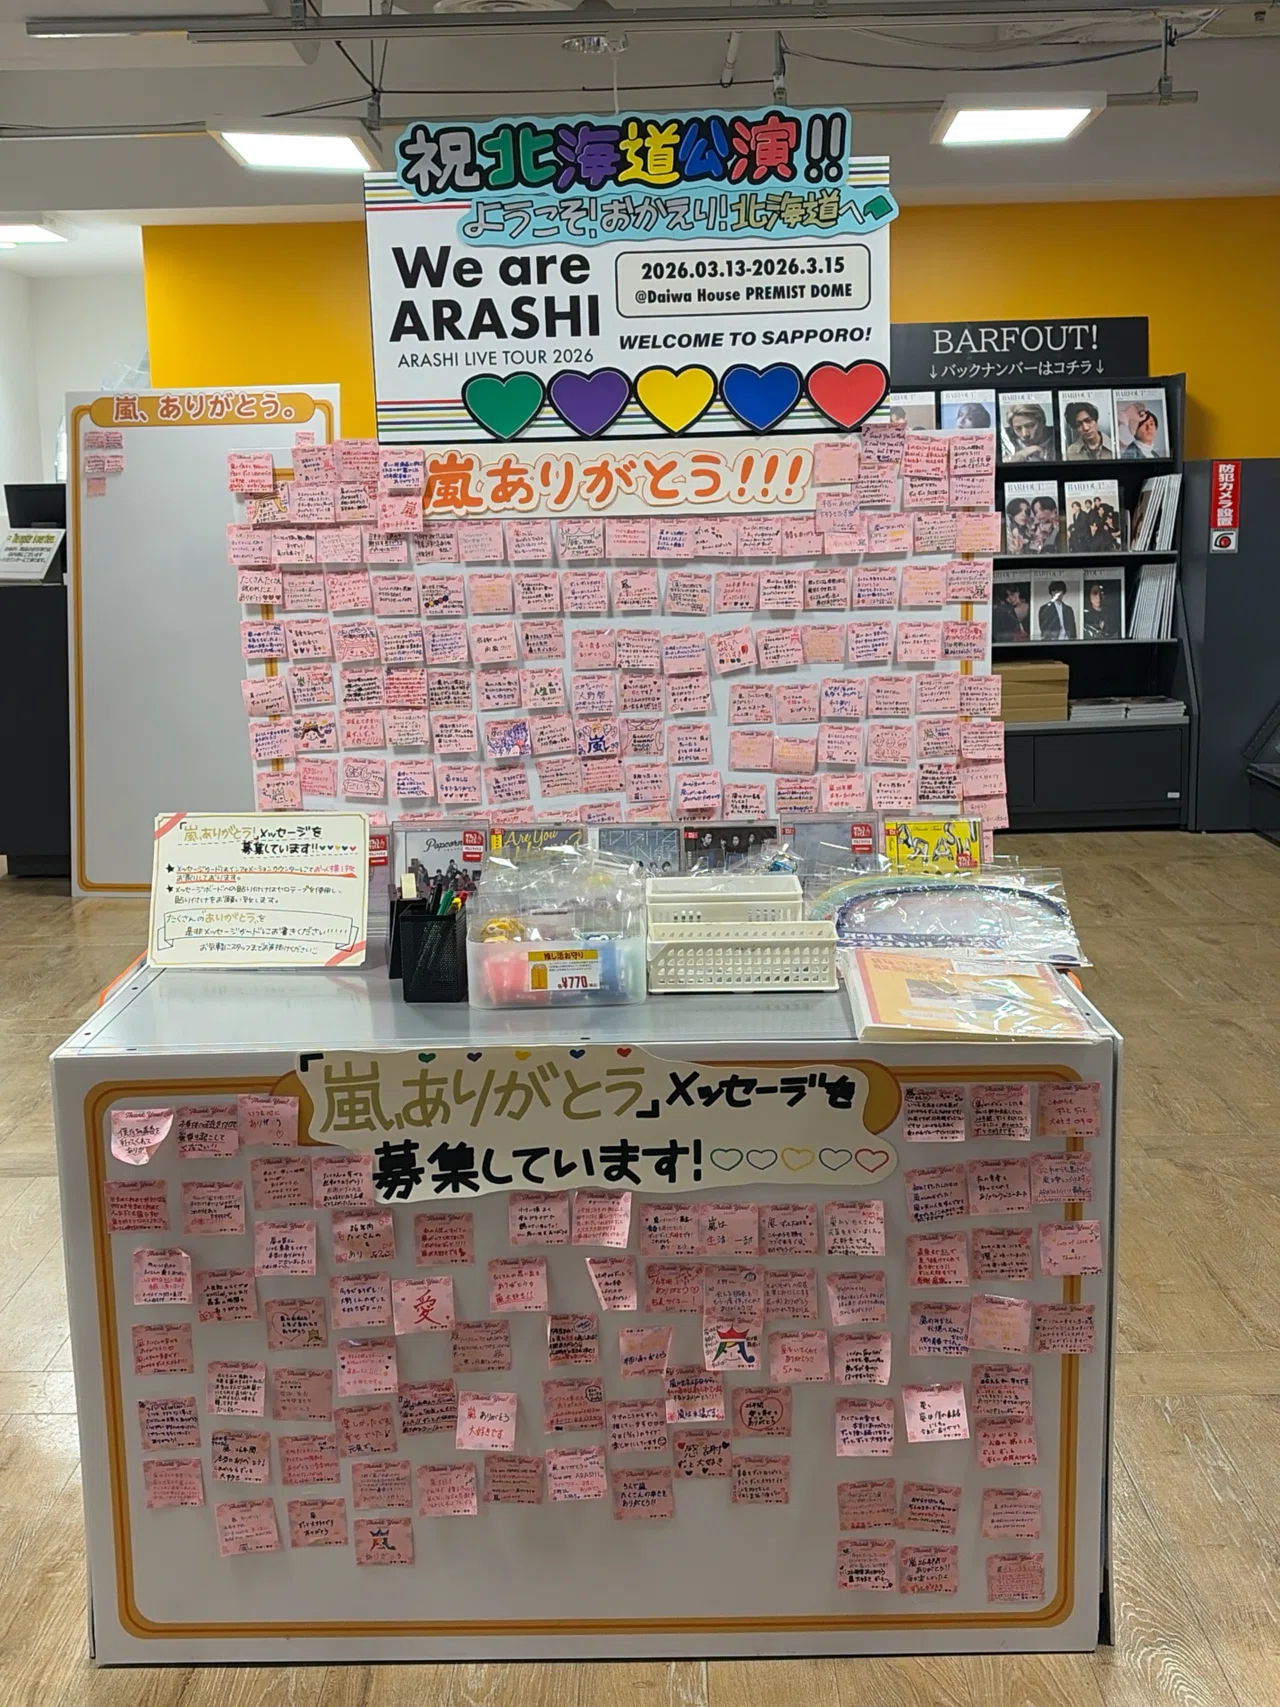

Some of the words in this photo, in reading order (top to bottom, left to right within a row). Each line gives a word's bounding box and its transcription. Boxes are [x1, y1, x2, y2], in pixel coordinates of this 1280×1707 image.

[401, 112, 844, 194] 祝北海道公演!!
[391, 247, 483, 289] We
[499, 251, 591, 287] are
[641, 256, 845, 281] 2026.03.13-2026.3.15
[635, 288, 693, 306] @Daiwa
[697, 288, 740, 303] House
[745, 285, 808, 301] PREMIST
[810, 284, 853, 299] DOME
[390, 295, 600, 343] ARASHI
[619, 332, 723, 350] WELCOME
[728, 331, 757, 349] TO
[760, 327, 873, 347] SAPPORO!
[932, 326, 1100, 355] BARFOUT!
[398, 352, 459, 368] ARASHI
[465, 351, 497, 366] LIVE
[502, 350, 547, 365] TOUR
[553, 349, 594, 364] 2026
[941, 362, 1092, 378] バックナンバーはコチラ
[114, 393, 296, 421] 嵐、ありがとう。
[1217, 463, 1236, 527] 防犯カメラ設置
[210, 1106, 228, 1114] You!
[346, 1156, 362, 1164] You!
[373, 1139, 703, 1201] 募集しています!
[982, 1160, 1000, 1168] Thank
[920, 1234, 938, 1242] Thank
[414, 1289, 442, 1325] 愛
[765, 1386, 782, 1394] You!
[639, 1400, 656, 1408] You!
